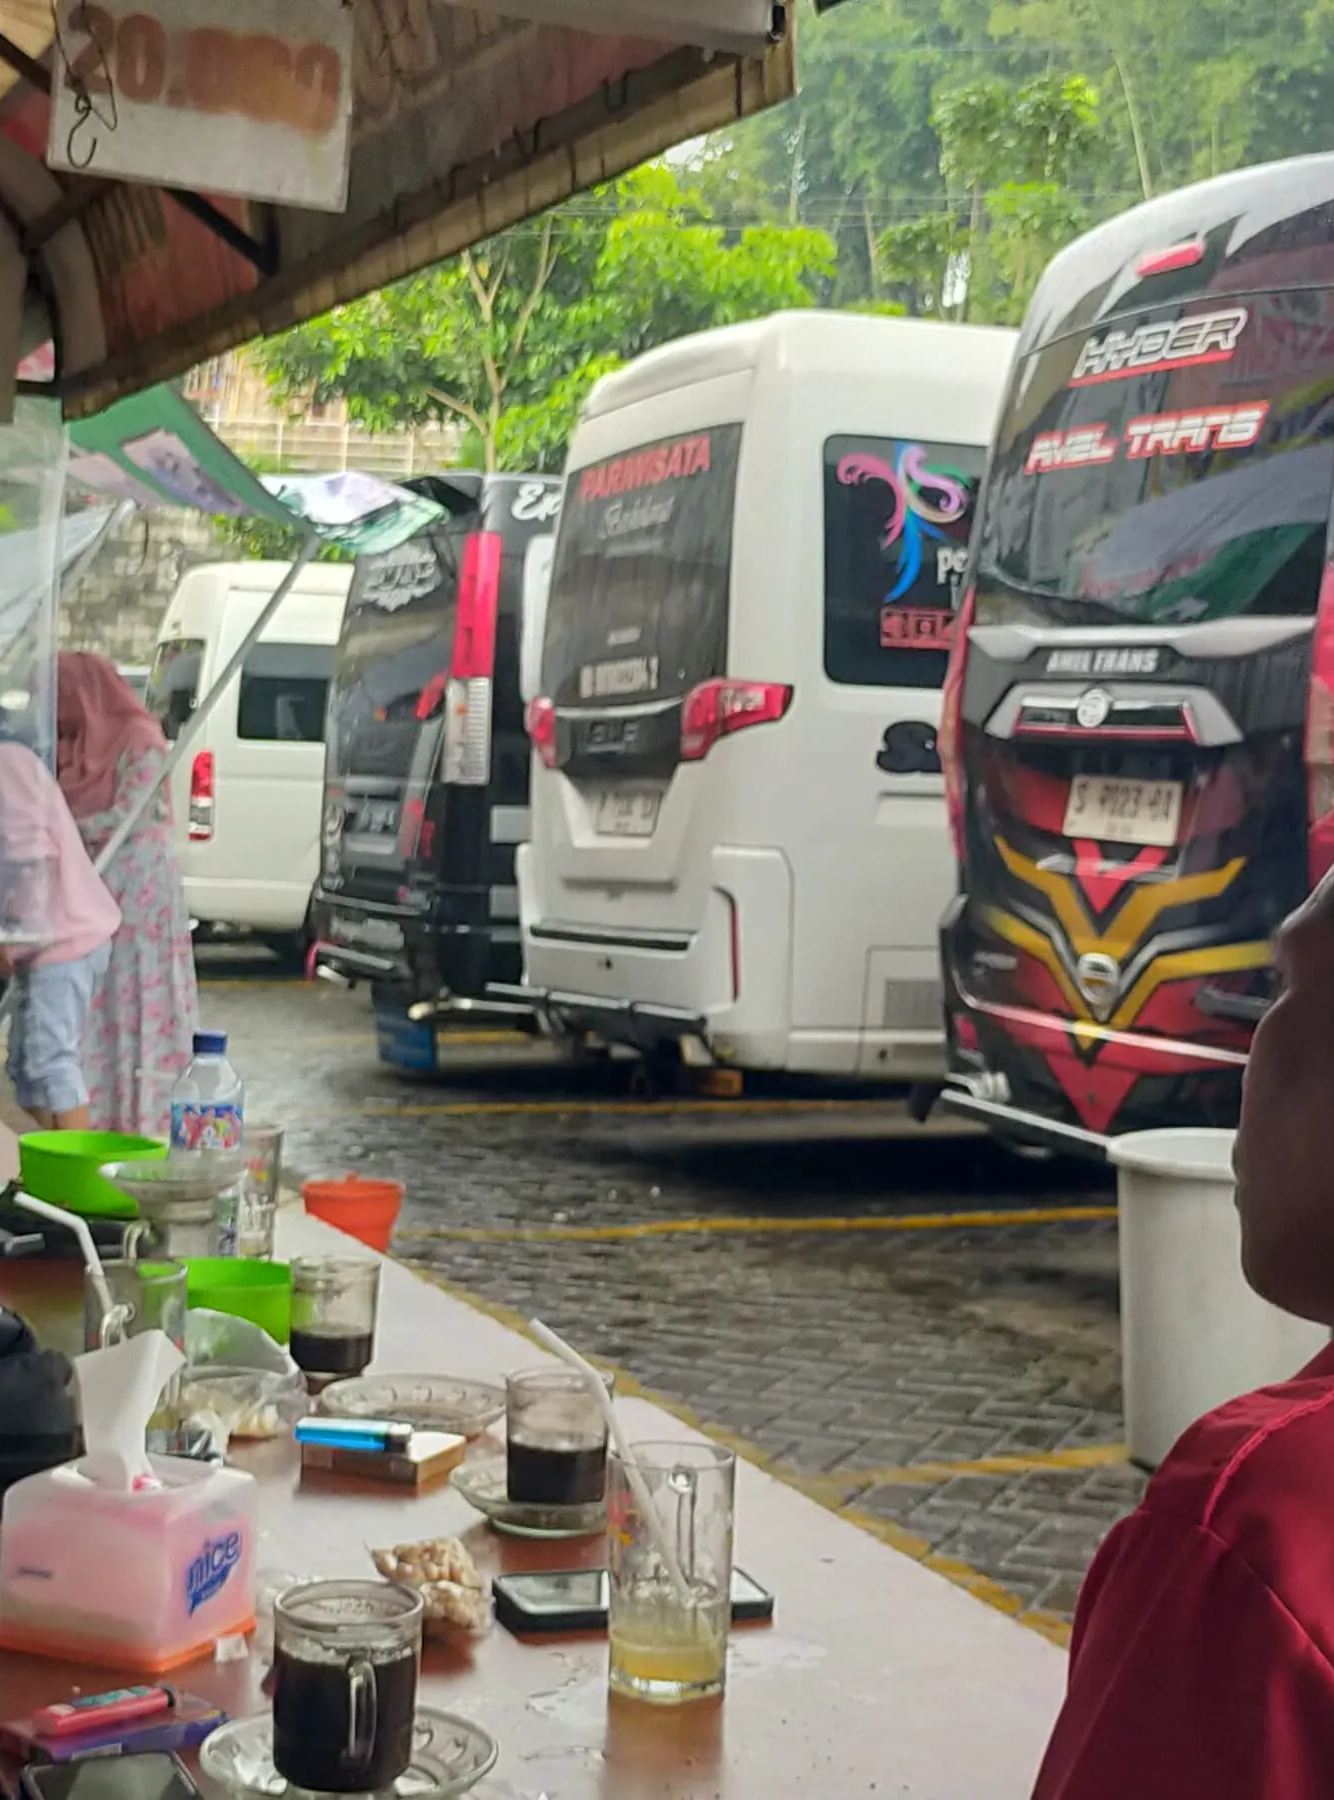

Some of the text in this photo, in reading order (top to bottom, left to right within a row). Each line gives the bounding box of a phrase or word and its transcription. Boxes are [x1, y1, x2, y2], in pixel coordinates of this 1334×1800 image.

[1125, 402, 1270, 459] TRANS
[577, 433, 712, 506] PARIWISATA
[186, 1529, 242, 1597] nice
